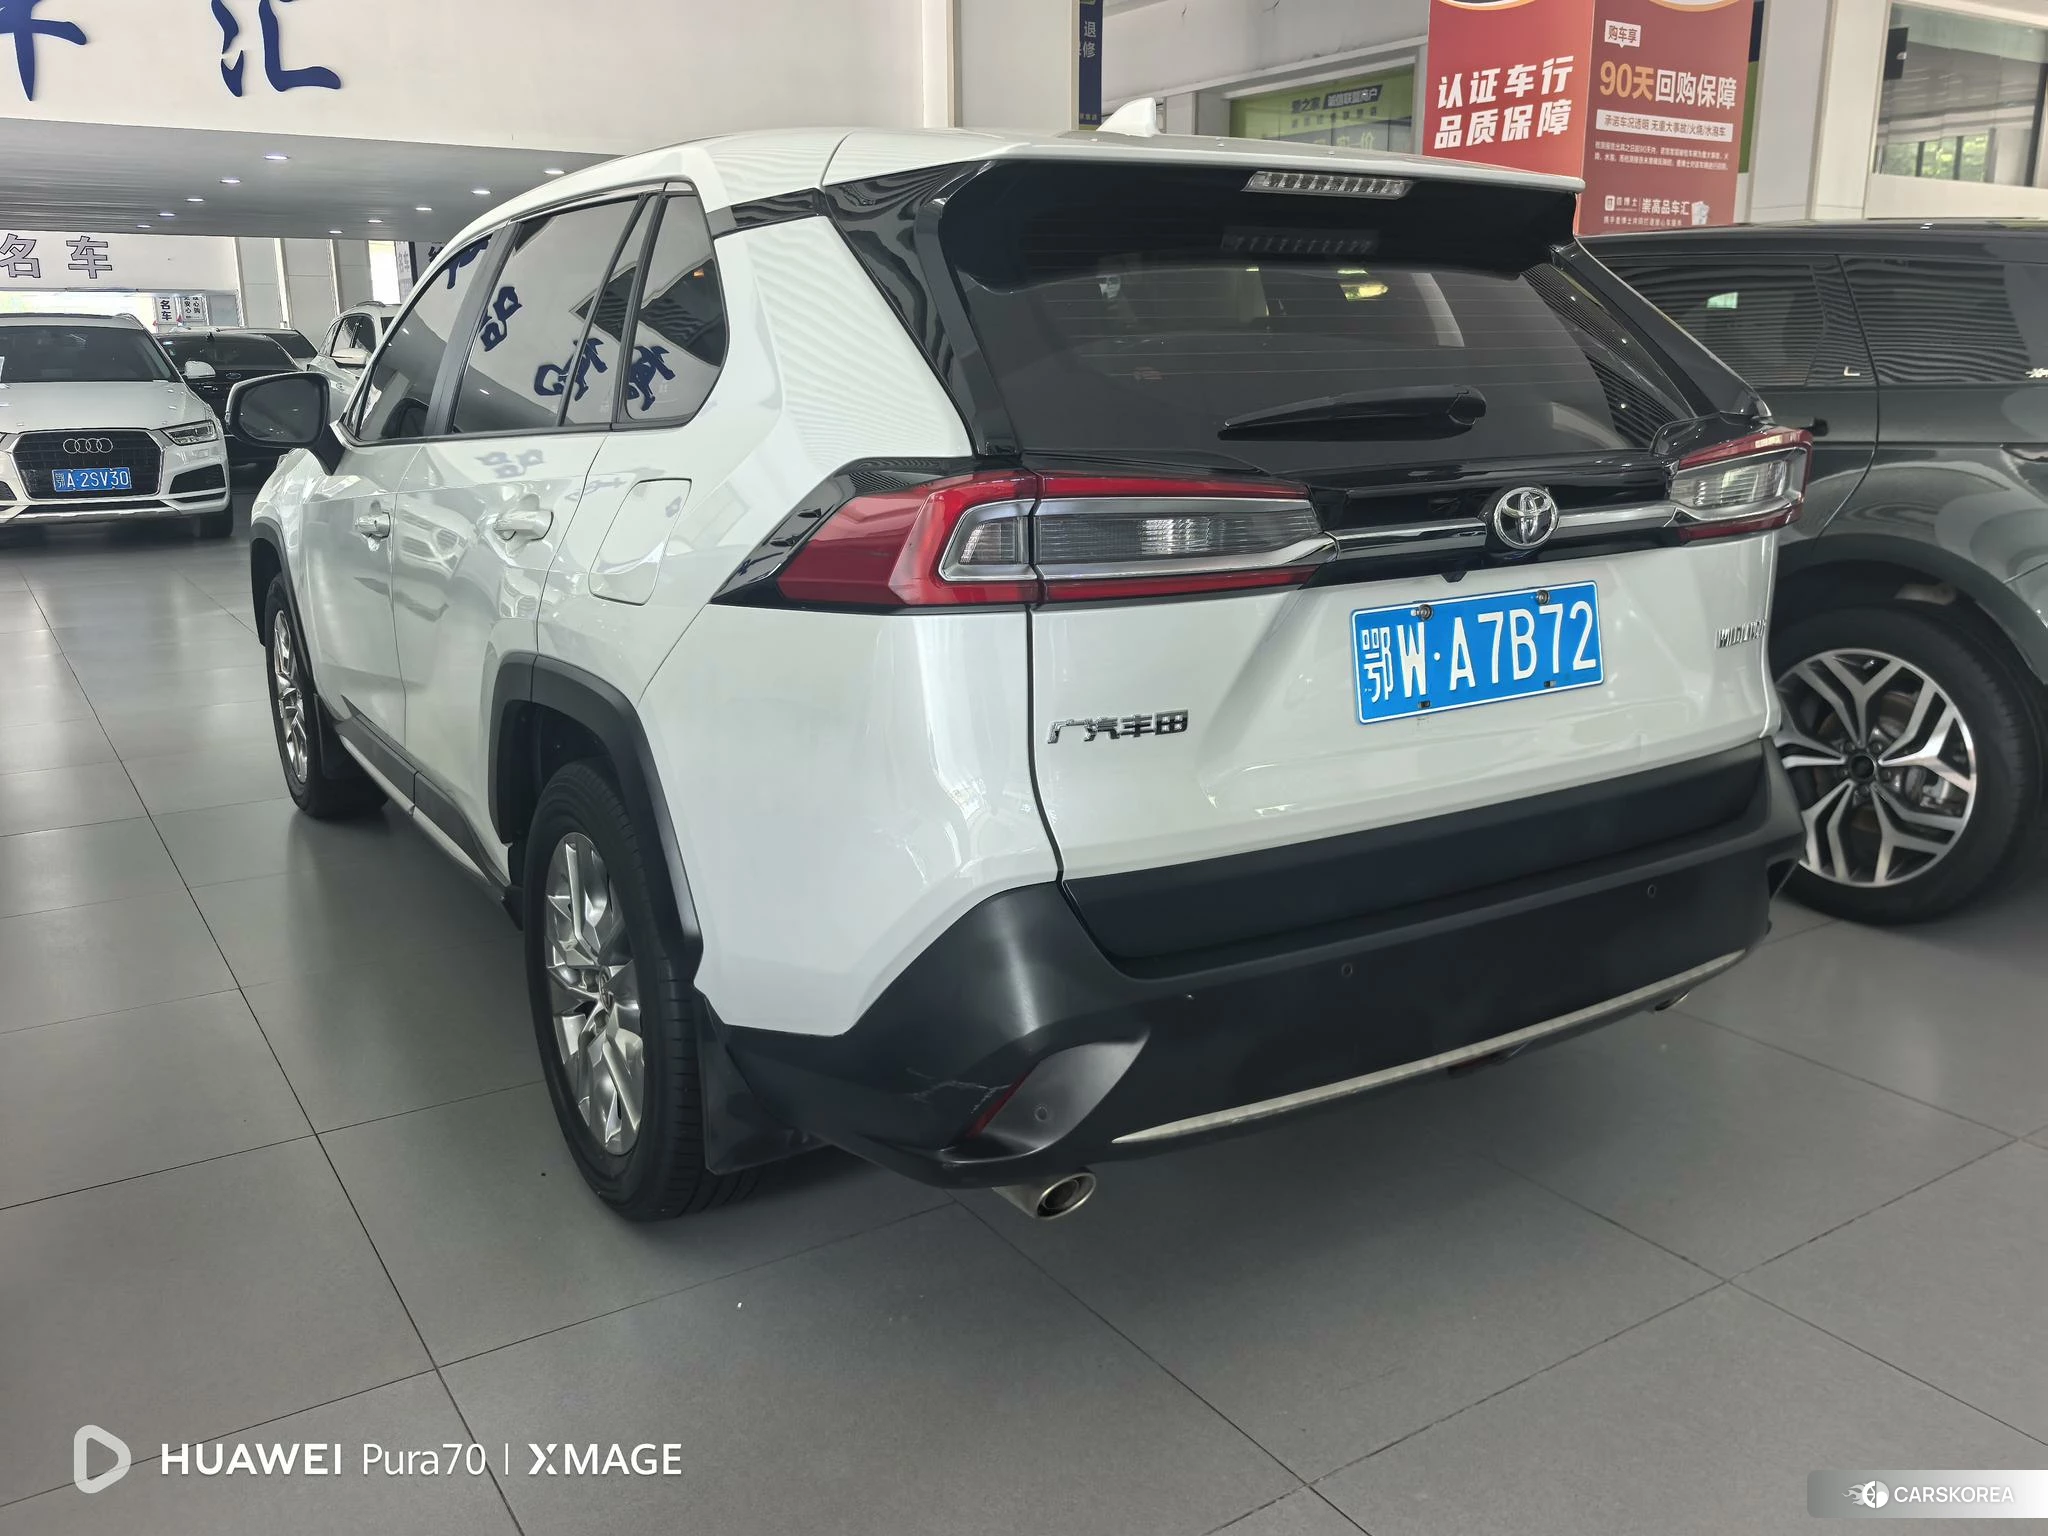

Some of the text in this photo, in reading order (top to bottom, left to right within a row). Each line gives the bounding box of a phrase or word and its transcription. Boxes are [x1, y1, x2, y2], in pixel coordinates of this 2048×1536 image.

[1608, 24, 1638, 44] 购车享
[1437, 55, 1575, 110] 认证车行
[1599, 60, 1737, 110] 90天回购保障
[1433, 99, 1572, 150] 品质保障
[1641, 197, 1690, 216] 崇高品车汇
[0, 233, 113, 280] 名车
[160, 299, 172, 321] 名车
